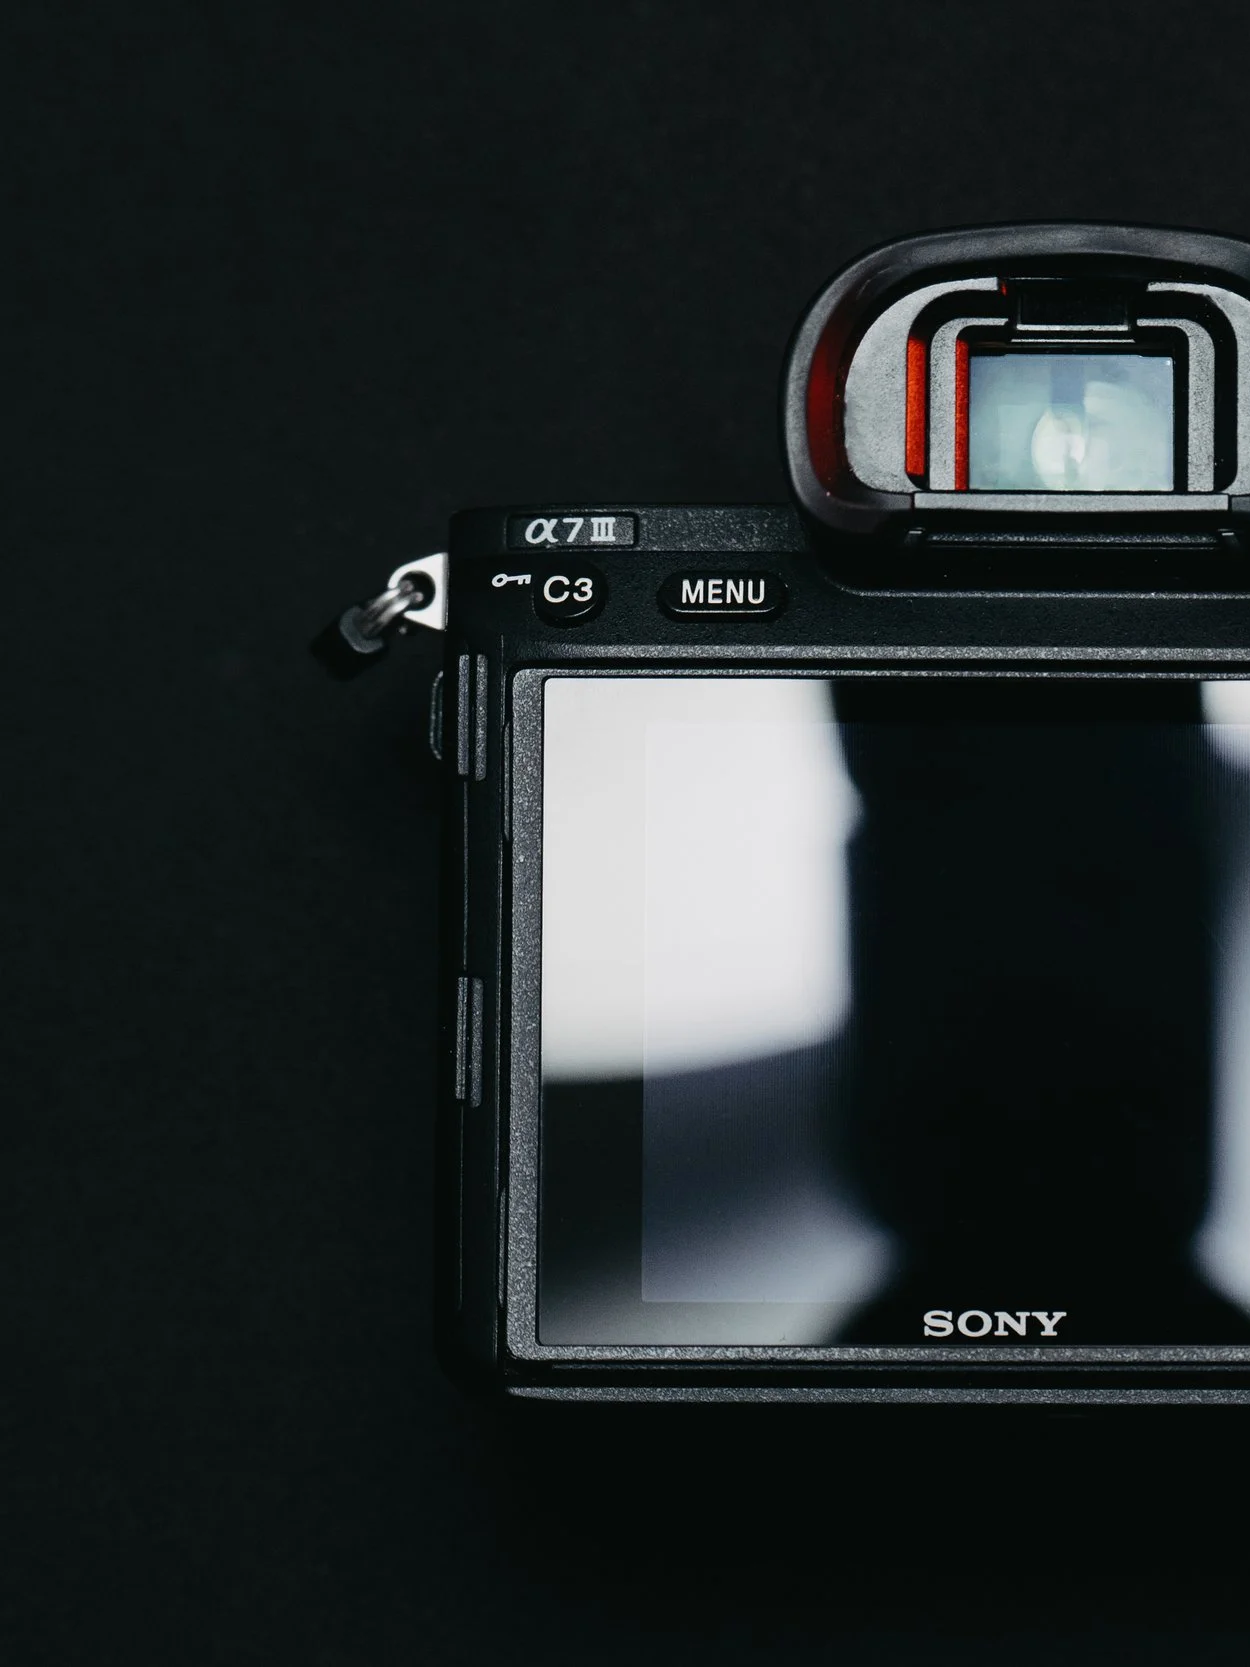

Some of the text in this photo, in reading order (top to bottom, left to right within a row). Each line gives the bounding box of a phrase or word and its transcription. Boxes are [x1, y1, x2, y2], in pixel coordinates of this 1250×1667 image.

[543, 575, 593, 603] C3
[681, 578, 766, 604] MENU
[923, 1310, 1067, 1337] SONY
